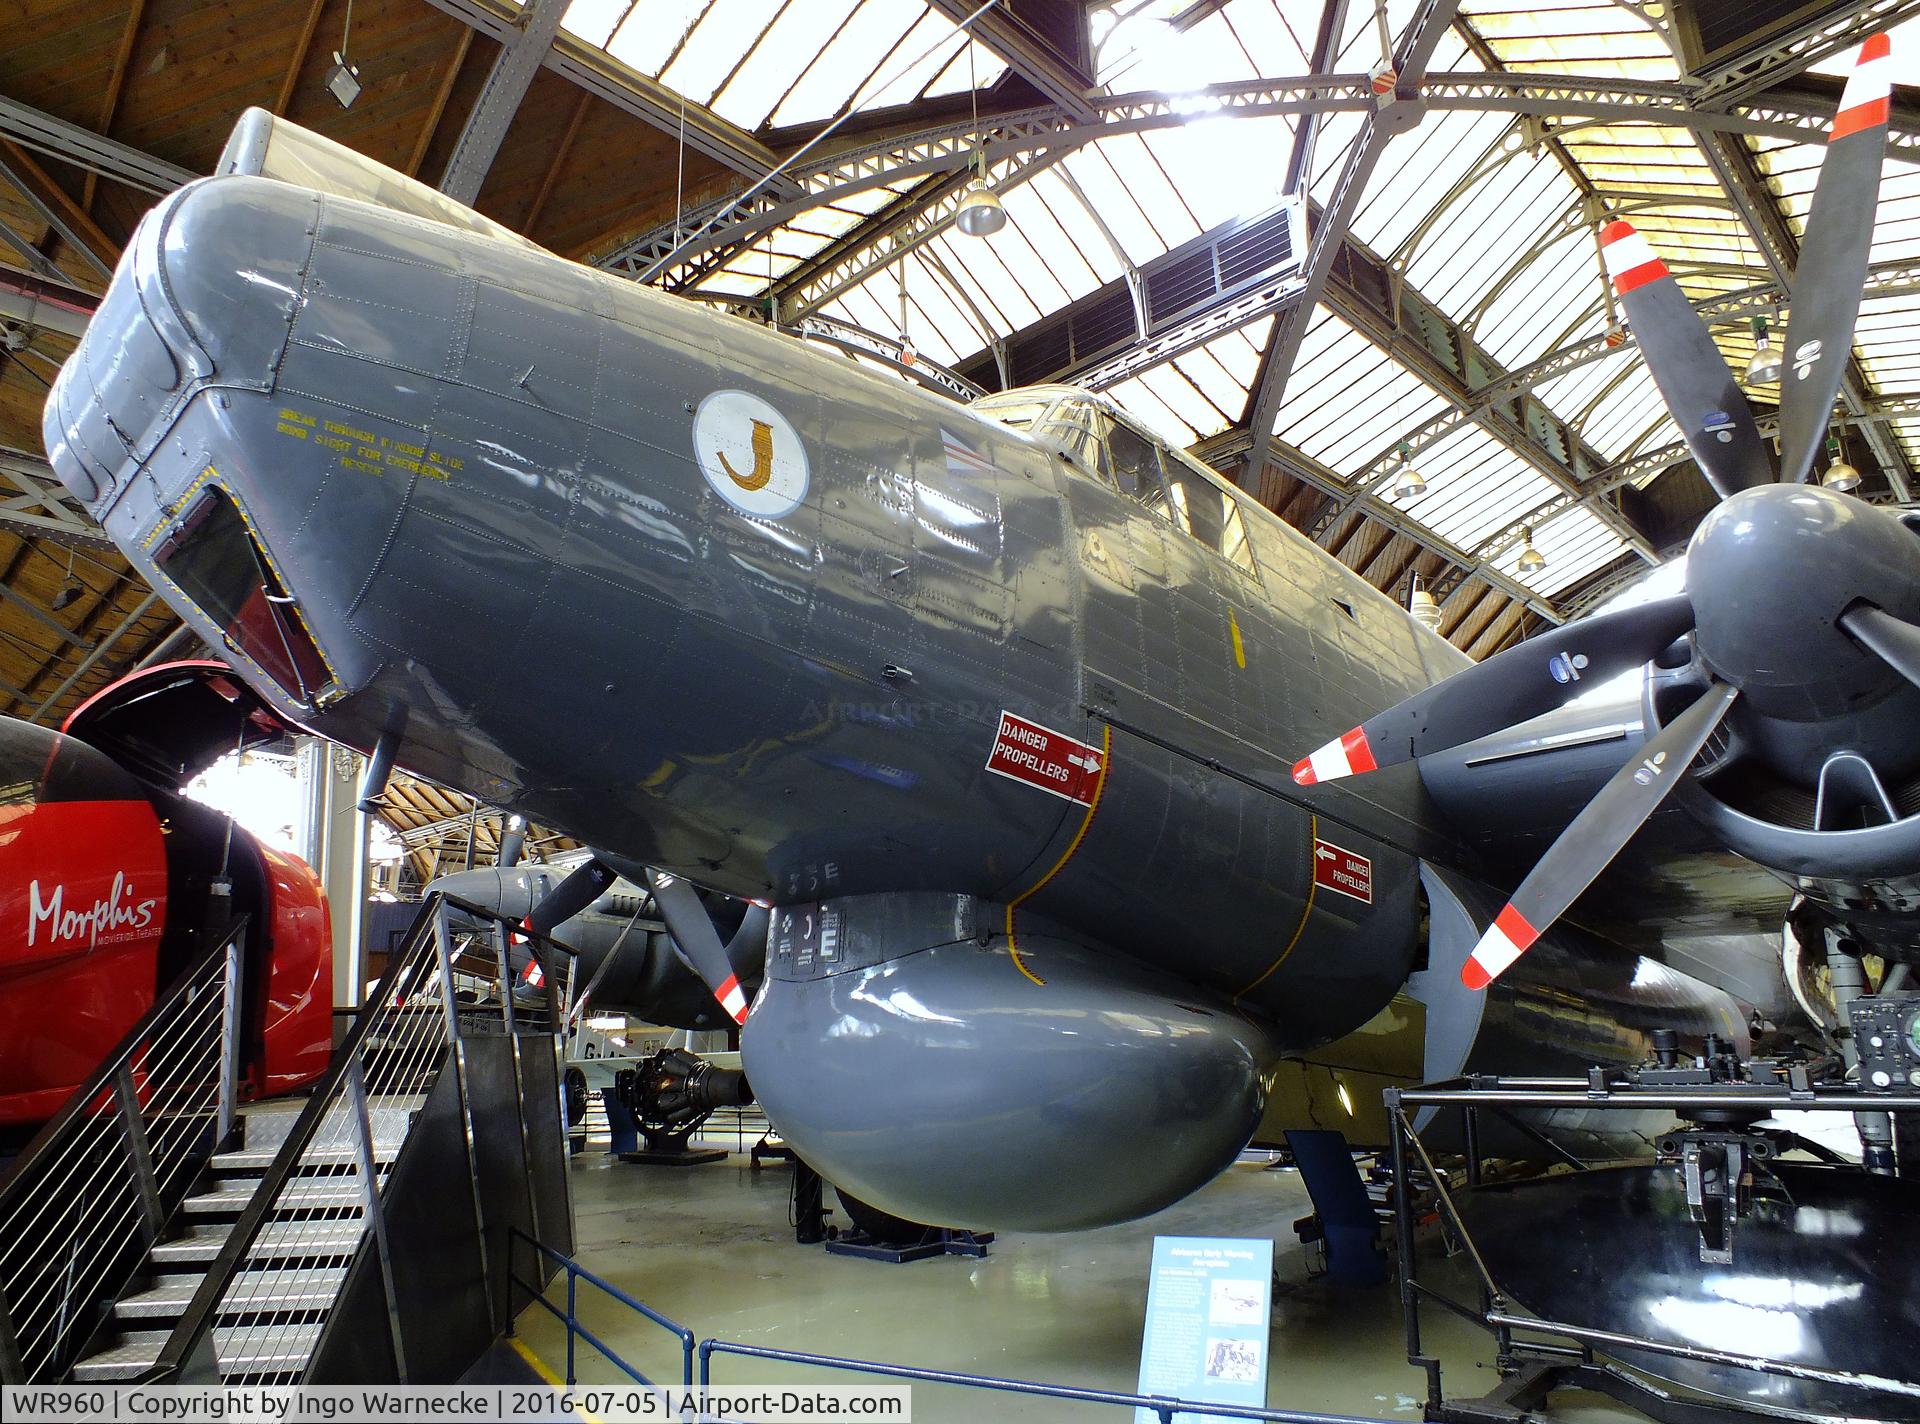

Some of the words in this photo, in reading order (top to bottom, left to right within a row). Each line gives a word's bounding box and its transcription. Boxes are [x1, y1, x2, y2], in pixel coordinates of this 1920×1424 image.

[324, 420, 376, 443] THROUGH
[380, 437, 425, 458] WINDOW
[314, 434, 352, 452] SIGHT
[357, 447, 382, 461] FOR
[385, 454, 451, 481] EMERGENCY
[1001, 721, 1048, 752] DANGER
[995, 742, 1069, 782] PROPELLERS
[1333, 870, 1370, 893] PROPELLERS
[1346, 860, 1369, 878] DANGER
[28, 871, 156, 956] Morphis
[98, 931, 135, 945] MOVIERIDE
[136, 927, 163, 940] THEATER
